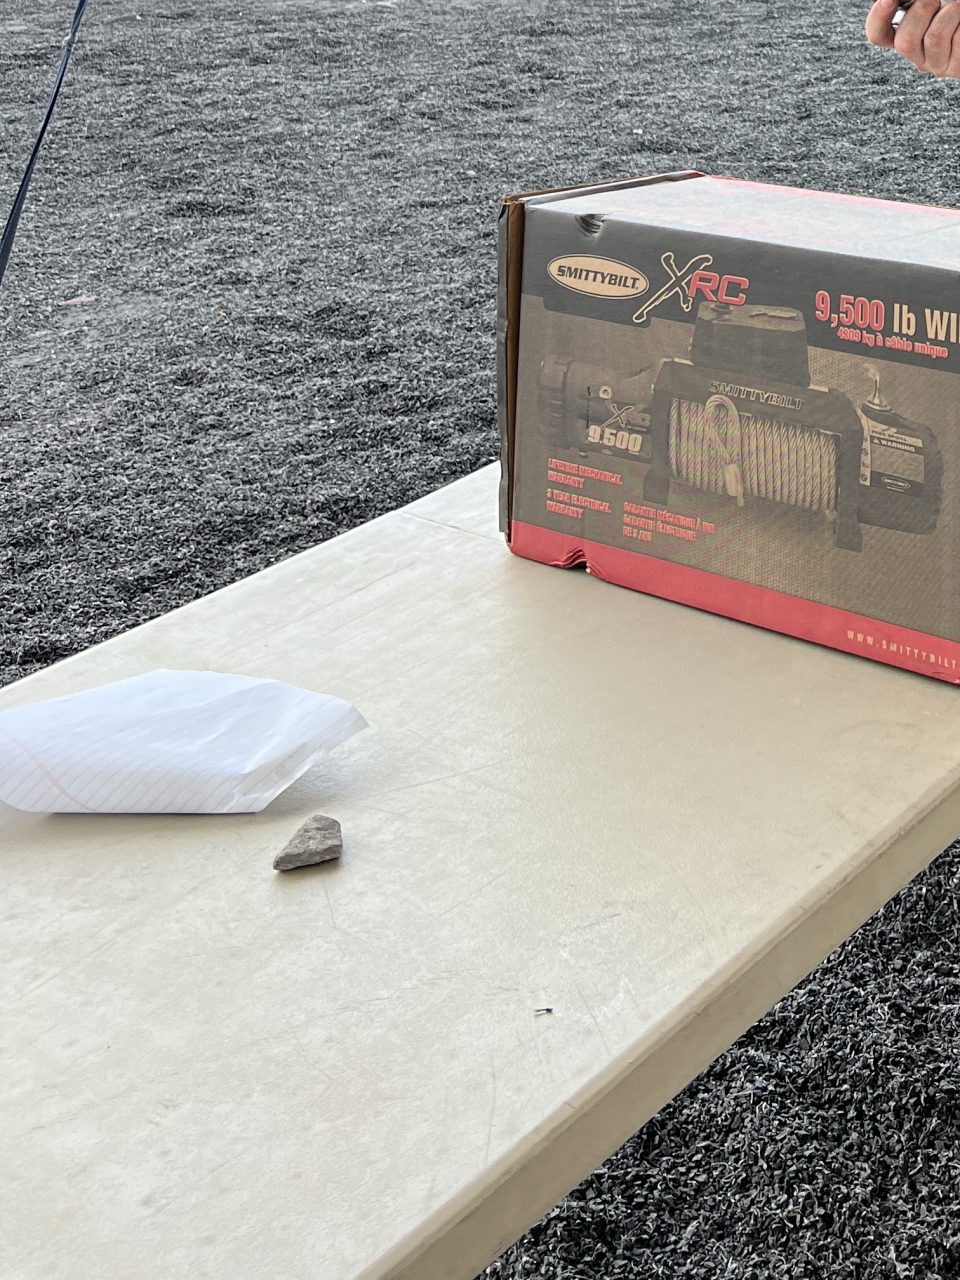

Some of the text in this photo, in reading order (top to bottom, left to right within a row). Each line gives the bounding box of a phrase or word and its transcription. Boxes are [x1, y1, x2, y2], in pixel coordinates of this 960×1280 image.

[556, 252, 749, 323] SMITTYBILT XRC
[815, 289, 886, 331] 9,500
[893, 302, 916, 337] lb
[861, 330, 876, 348] kg
[876, 332, 884, 347] à
[884, 335, 913, 353] câble
[914, 342, 949, 359] unique
[708, 380, 805, 411] SMITTYBILT
[881, 439, 916, 452] WARNING
[548, 470, 584, 489] WARRANTY
[546, 500, 584, 519] WARRANTY
